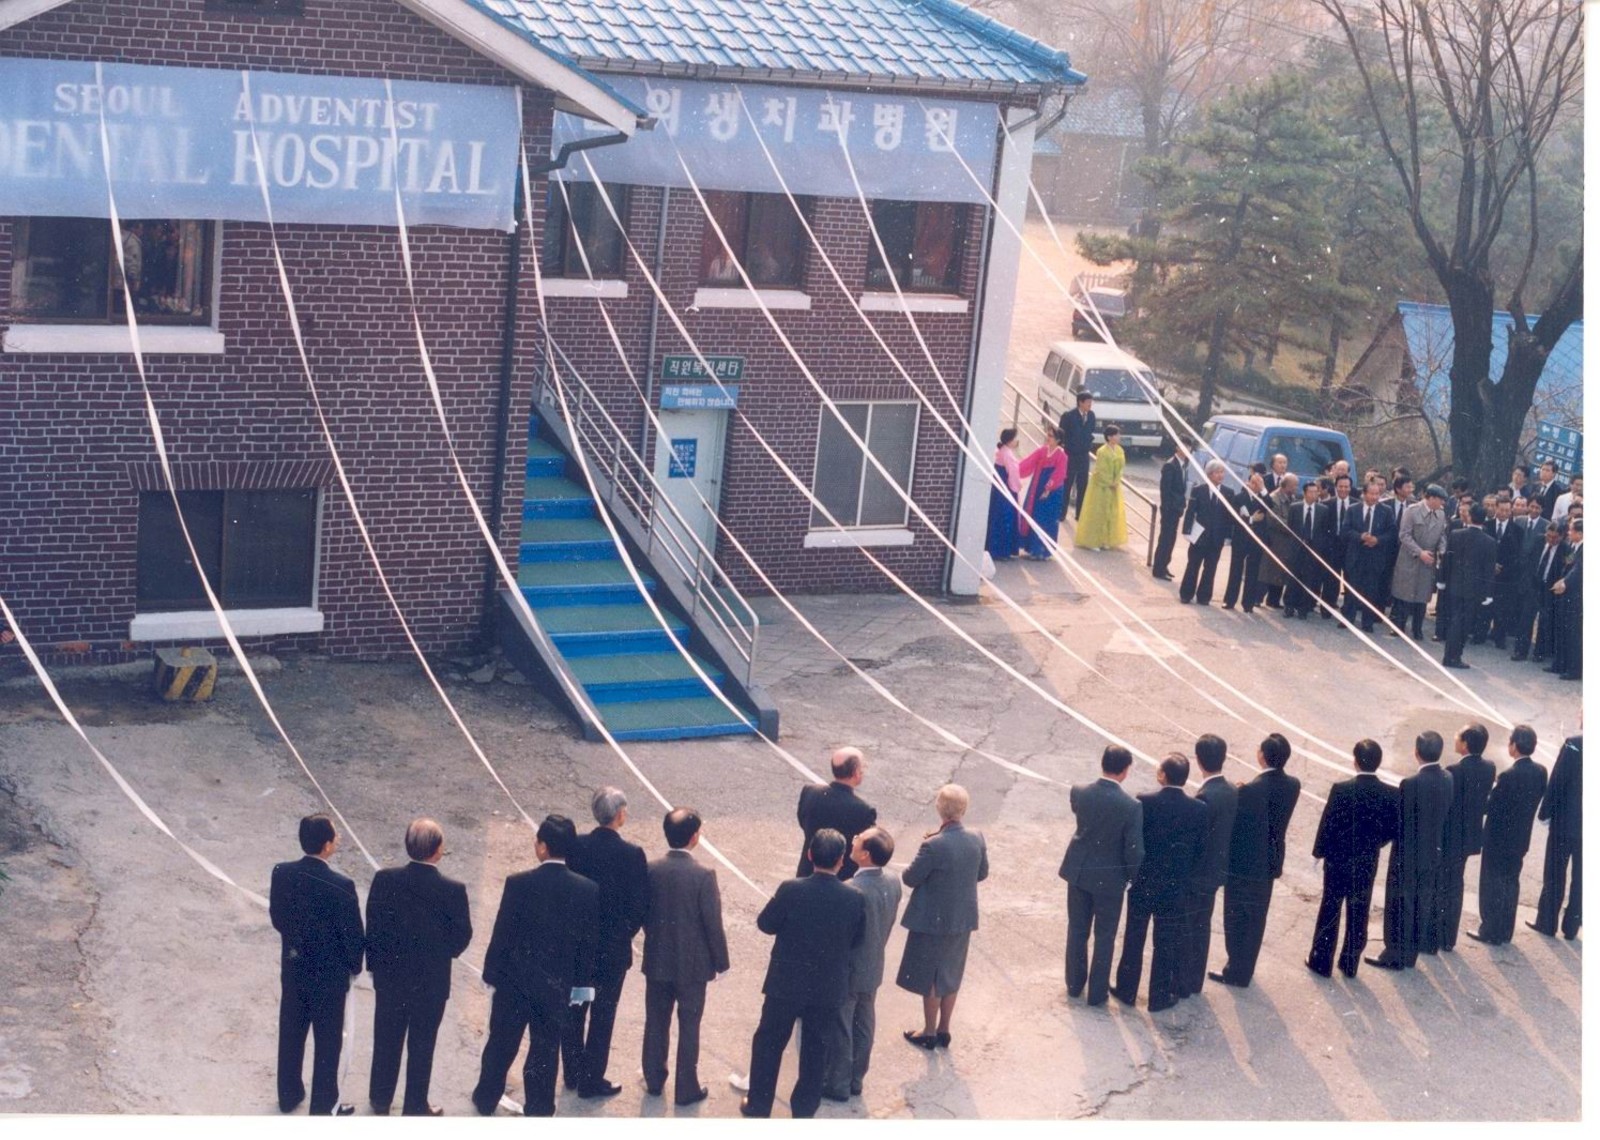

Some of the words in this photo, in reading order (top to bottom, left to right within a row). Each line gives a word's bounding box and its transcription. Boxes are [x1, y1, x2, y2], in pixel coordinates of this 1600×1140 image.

[53, 82, 183, 117] SEOUL
[233, 92, 440, 133] ADVENTIST
[230, 130, 499, 194] HOSPITAL
